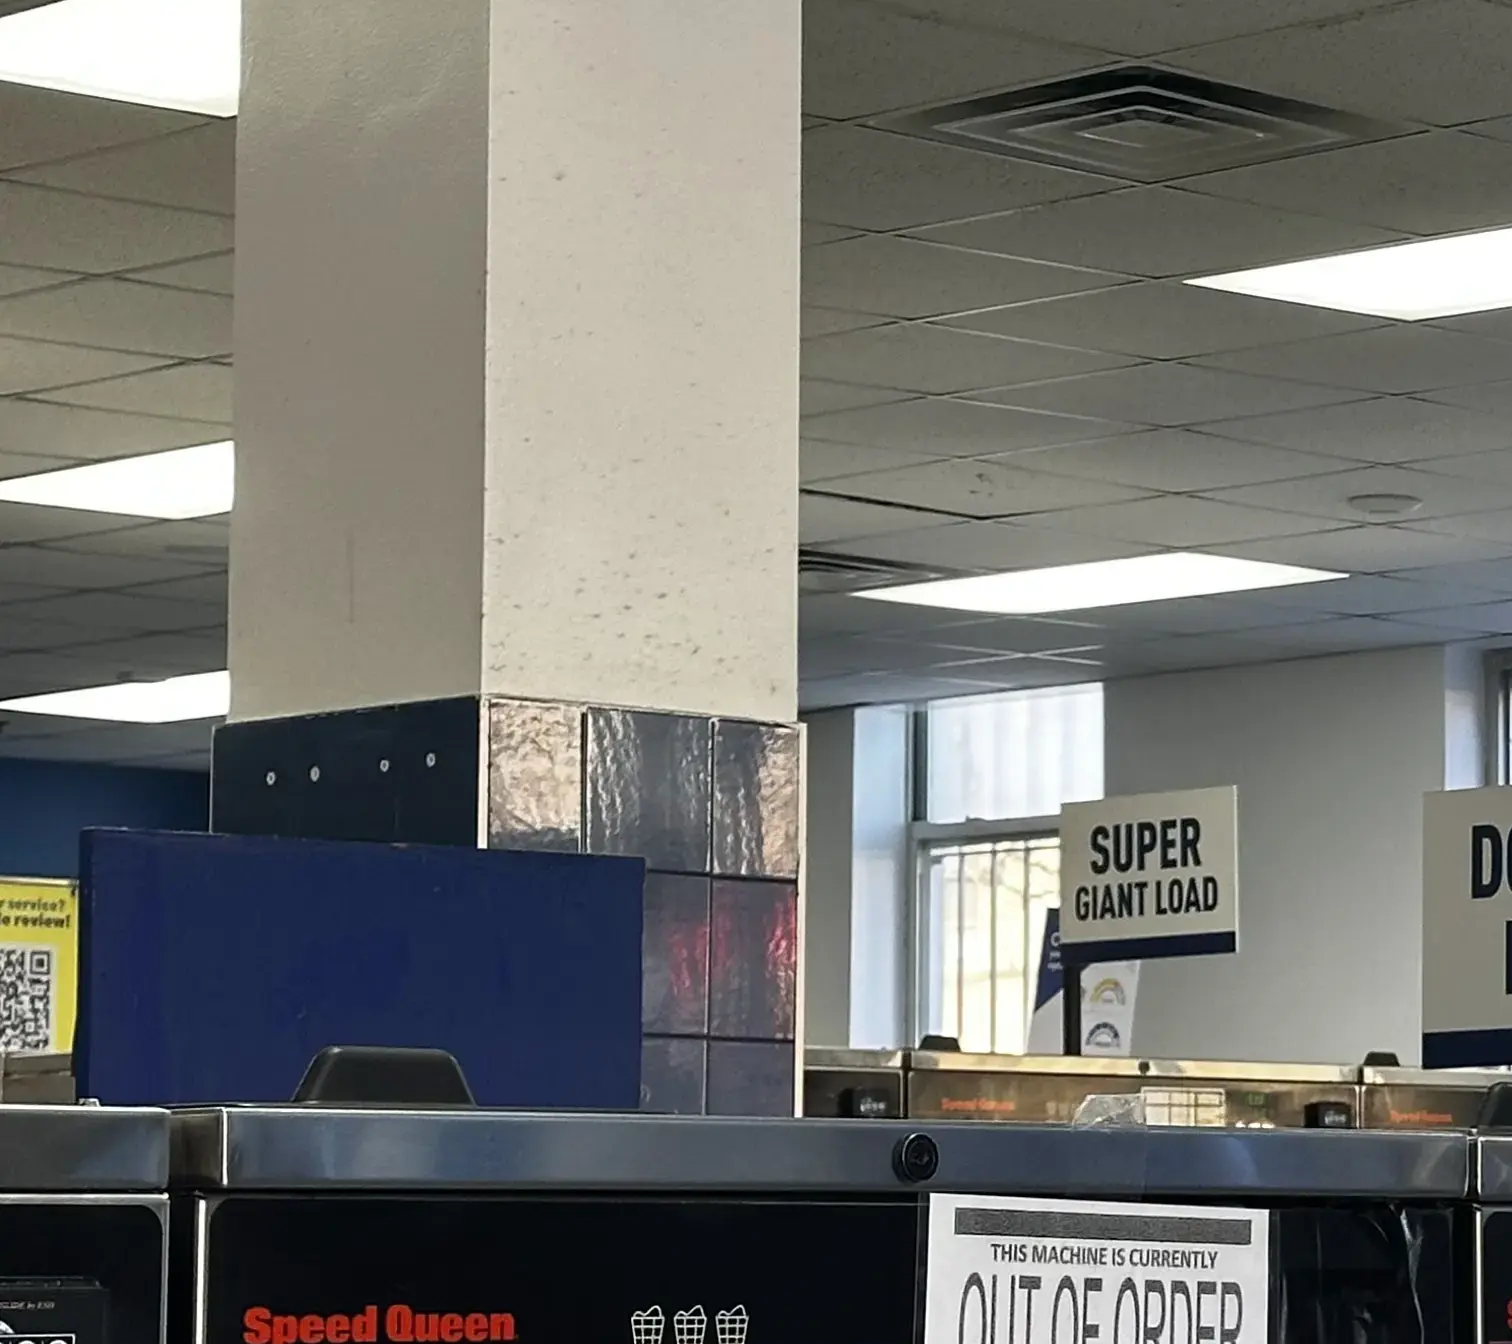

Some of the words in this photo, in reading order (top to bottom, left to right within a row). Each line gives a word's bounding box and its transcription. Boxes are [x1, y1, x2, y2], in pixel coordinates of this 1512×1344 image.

[1090, 817, 1202, 875] SUPER
[1075, 881, 1148, 921] GIANT
[1155, 876, 1218, 915] LOAD
[14, 913, 71, 929] review!
[990, 1243, 1027, 1264] THIS
[1032, 1245, 1107, 1265] MACHINE
[1112, 1249, 1125, 1266] IS
[1129, 1249, 1218, 1269] CURRENTLY
[386, 1304, 515, 1343] Queen
